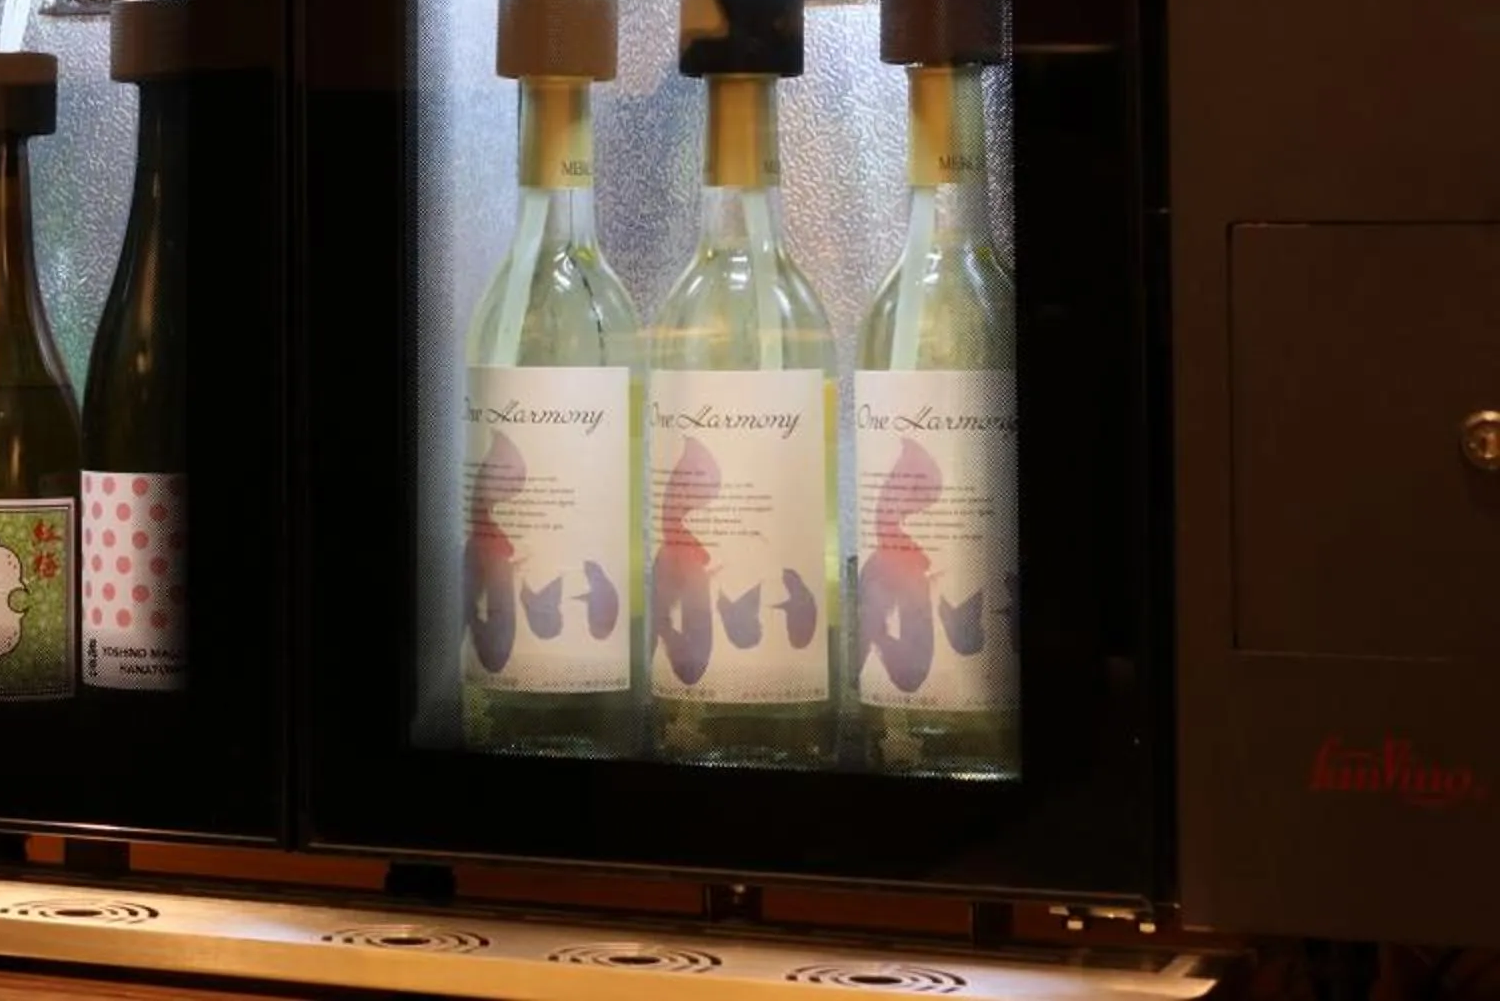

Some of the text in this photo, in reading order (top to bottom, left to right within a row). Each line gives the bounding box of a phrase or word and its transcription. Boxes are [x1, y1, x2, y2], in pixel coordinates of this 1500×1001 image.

[485, 399, 604, 435] Harmony
[676, 404, 802, 439] Harmony
[857, 403, 890, 430] One
